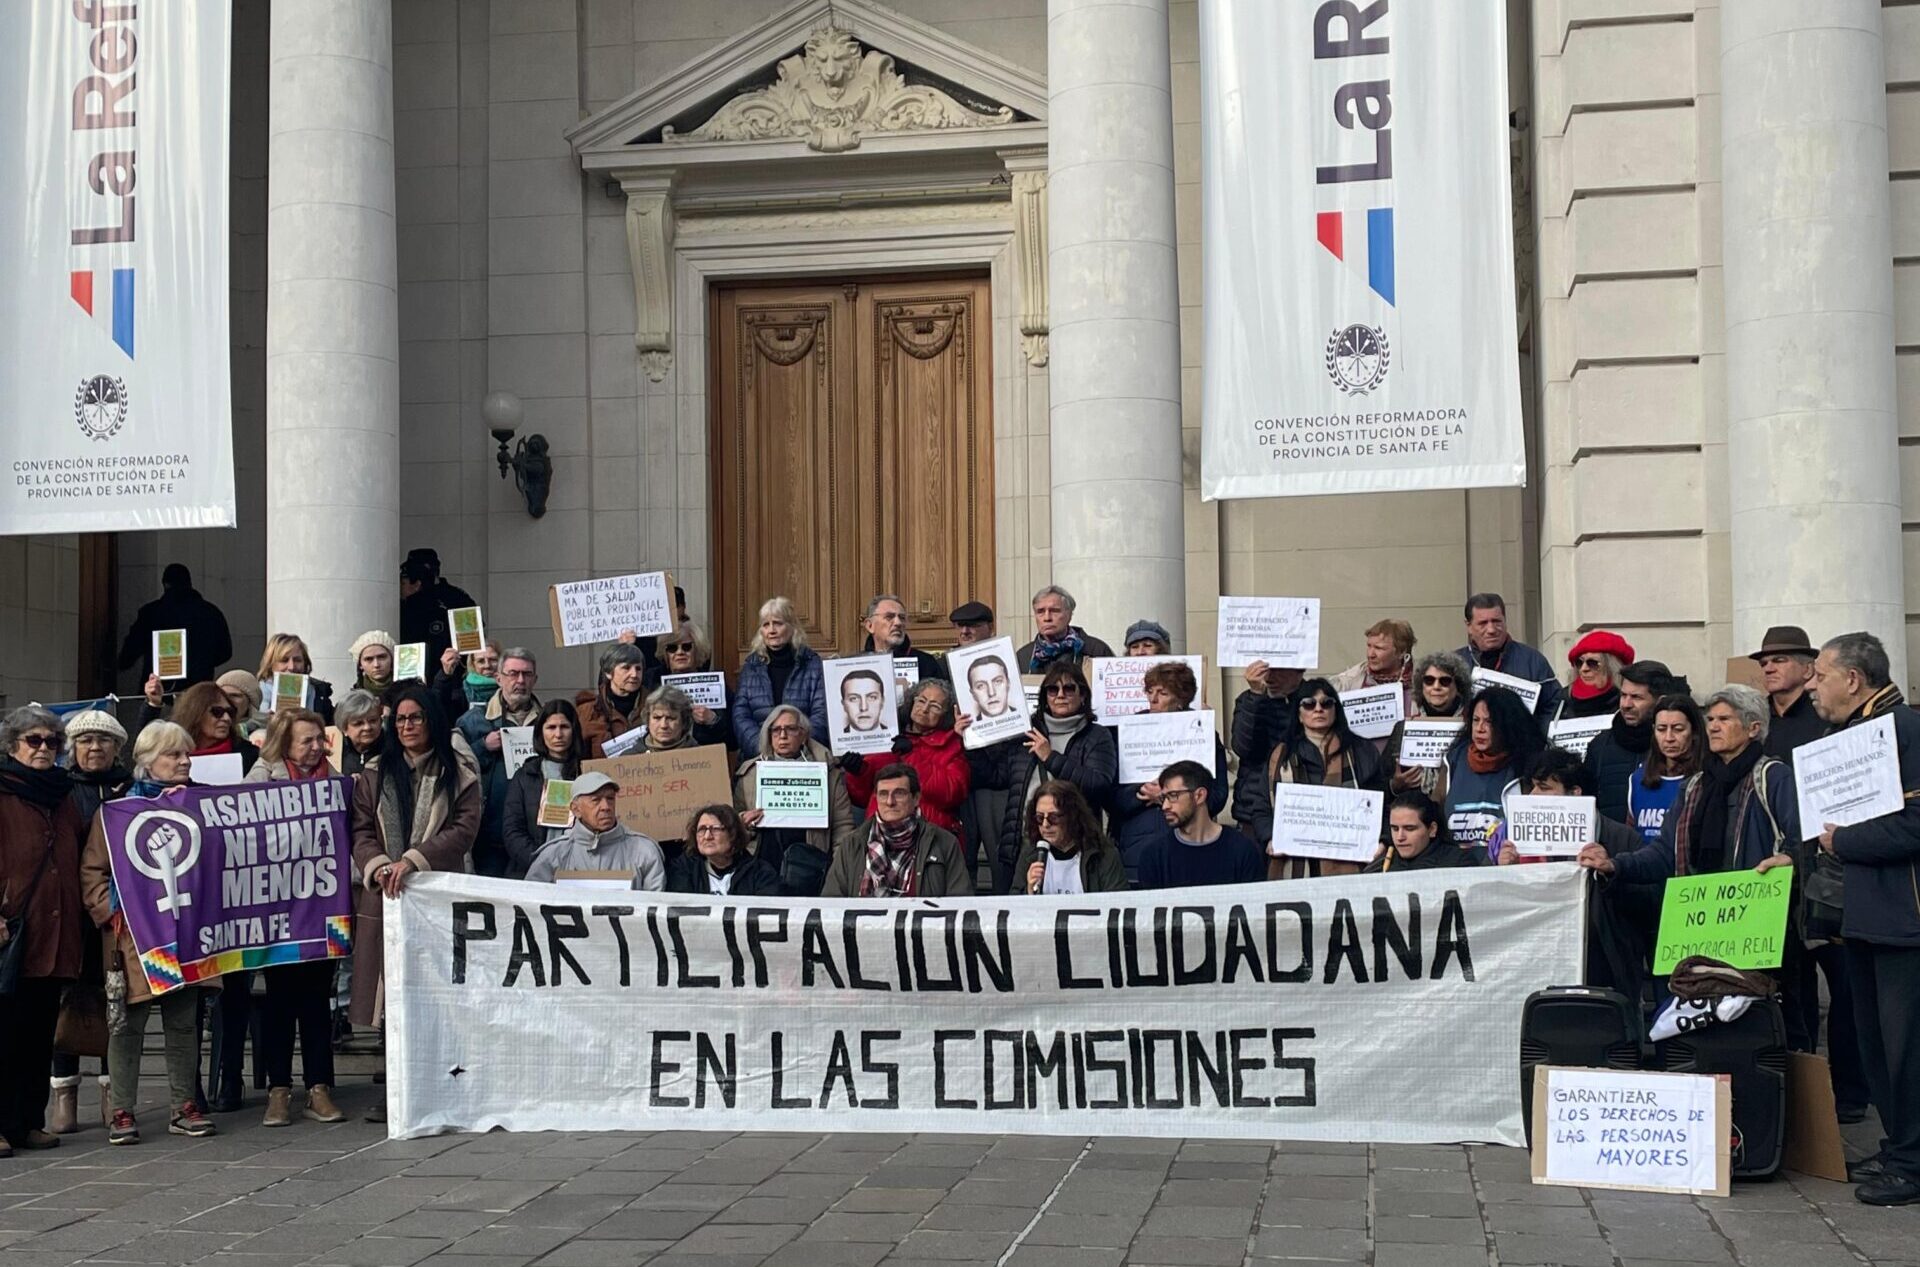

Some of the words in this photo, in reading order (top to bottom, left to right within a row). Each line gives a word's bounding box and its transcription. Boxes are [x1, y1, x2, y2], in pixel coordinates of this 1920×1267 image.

[1316, 79, 1393, 185] La
[72, 150, 136, 245] La
[1254, 413, 1350, 430] CONVENCIÓN
[1356, 408, 1467, 425] REFORMADORA
[1259, 434, 1276, 445] DE
[1282, 433, 1299, 444] LA
[1305, 425, 1416, 443] CONSTITUCIÓN
[1421, 426, 1439, 437] DE
[1445, 424, 1463, 435] LA
[1273, 447, 1350, 459] PROVINCIA
[1356, 445, 1374, 455] DE
[1379, 442, 1427, 454] SANTA
[1433, 440, 1449, 451] FE
[13, 456, 93, 471] CONVENCIÓN
[97, 454, 189, 468] REFORMADORA
[16, 475, 31, 485] DE
[36, 474, 51, 484] LA
[55, 469, 146, 484] CONSTITUCIÓN
[151, 469, 166, 480] DE
[170, 469, 186, 479] LA
[28, 487, 92, 499] PROVINCIA
[97, 486, 111, 496] DE
[116, 484, 156, 495] SANTA
[160, 483, 173, 493] FE
[562, 580, 615, 595] GARANTIZAR
[620, 579, 630, 589] EL
[634, 575, 660, 587] SISTE
[564, 598, 578, 607] MA
[586, 595, 599, 606] DE
[605, 590, 635, 603] SALUD
[607, 600, 663, 614] PROVINCIAL
[567, 622, 585, 632] QUE
[591, 620, 607, 629] SEA
[611, 611, 660, 626] ACCESIBLE
[579, 633, 588, 643] DE
[1104, 677, 1115, 686] EL
[616, 761, 664, 779] Derechos
[672, 759, 712, 772] Humanos
[1804, 765, 1845, 785] DERECHOS
[616, 784, 653, 798] EBEN
[663, 780, 689, 793] SER
[199, 780, 347, 827] ASAMBLEA
[1513, 811, 1557, 824] DERECHO
[1558, 812, 1566, 824] A
[1568, 813, 1586, 825] SER
[223, 827, 257, 868] NI
[265, 817, 335, 862] UNA
[1513, 825, 1587, 842] DIFERENTE
[222, 857, 338, 909] MENOS
[1679, 886, 1707, 903] SIN
[1716, 880, 1783, 900] NOSOTRAS
[1686, 911, 1706, 927] NO
[1716, 904, 1748, 924] HAY
[200, 917, 265, 955] SANTA
[269, 913, 290, 941] FE
[1055, 890, 1475, 988] CIUDADANA
[1662, 940, 1735, 962] DEMOCRACIA
[1743, 936, 1776, 955] REAL
[647, 1031, 737, 1109] EN
[770, 1030, 902, 1109] LAS
[933, 1027, 1316, 1109] COMISIONES
[1554, 1089, 1658, 1106] GARANTIZAR
[1558, 1108, 1589, 1121] LOS
[1600, 1107, 1677, 1122] DERECHOS
[1688, 1110, 1705, 1122] DE
[1556, 1129, 1585, 1143] LAS
[1600, 1128, 1687, 1143] PERSONAS
[1596, 1149, 1689, 1167] MAYORES
